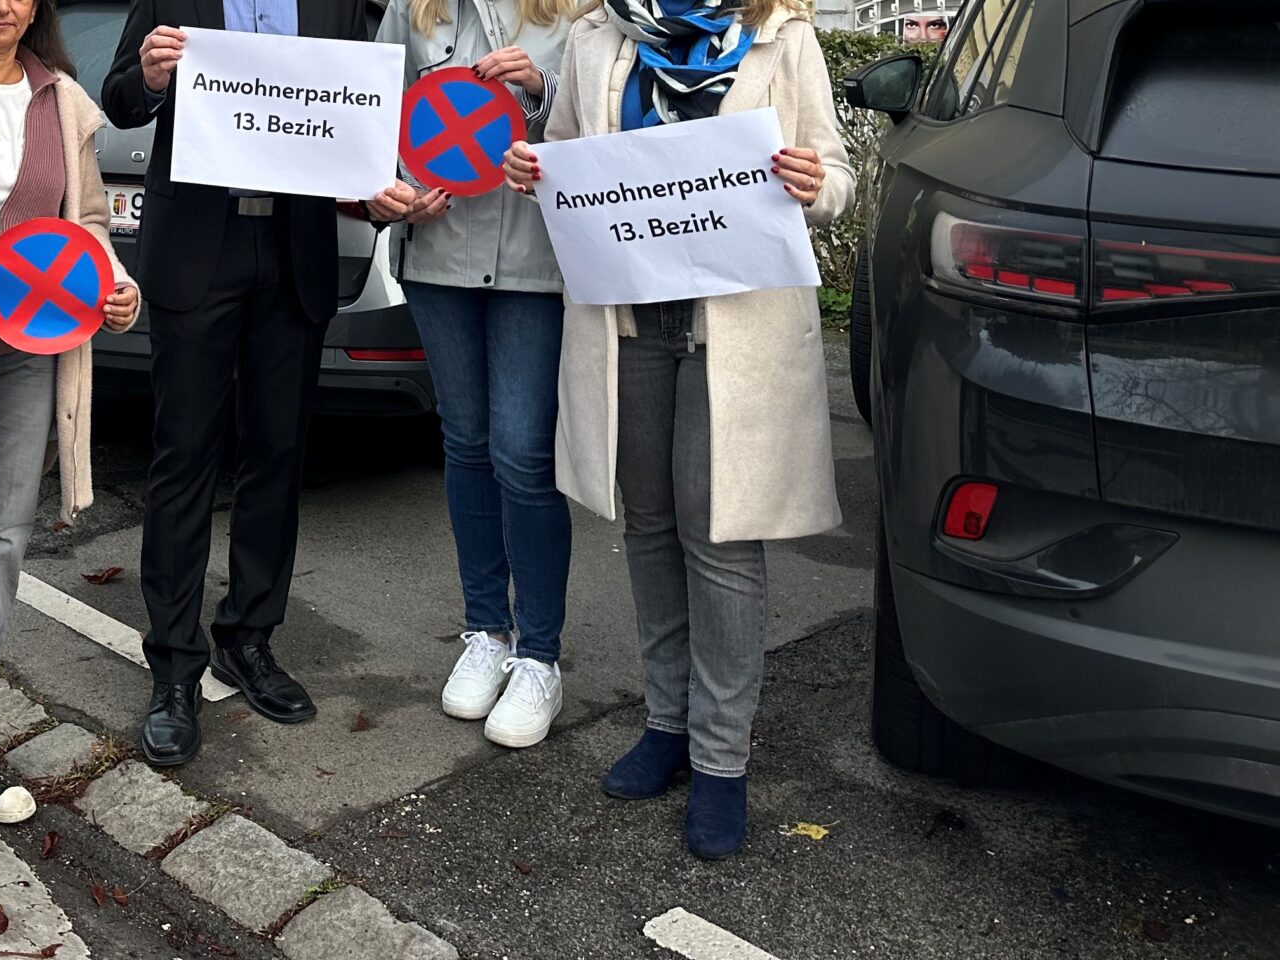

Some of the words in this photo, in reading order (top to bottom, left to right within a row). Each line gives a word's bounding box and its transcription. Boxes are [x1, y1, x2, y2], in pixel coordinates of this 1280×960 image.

[192, 72, 382, 107] Anwohnerparken
[233, 112, 261, 132] 13.
[267, 114, 335, 139] Bezirk
[555, 167, 768, 209] Anwohnerparken
[609, 221, 644, 243] 13.
[648, 210, 728, 239] Bezirk
